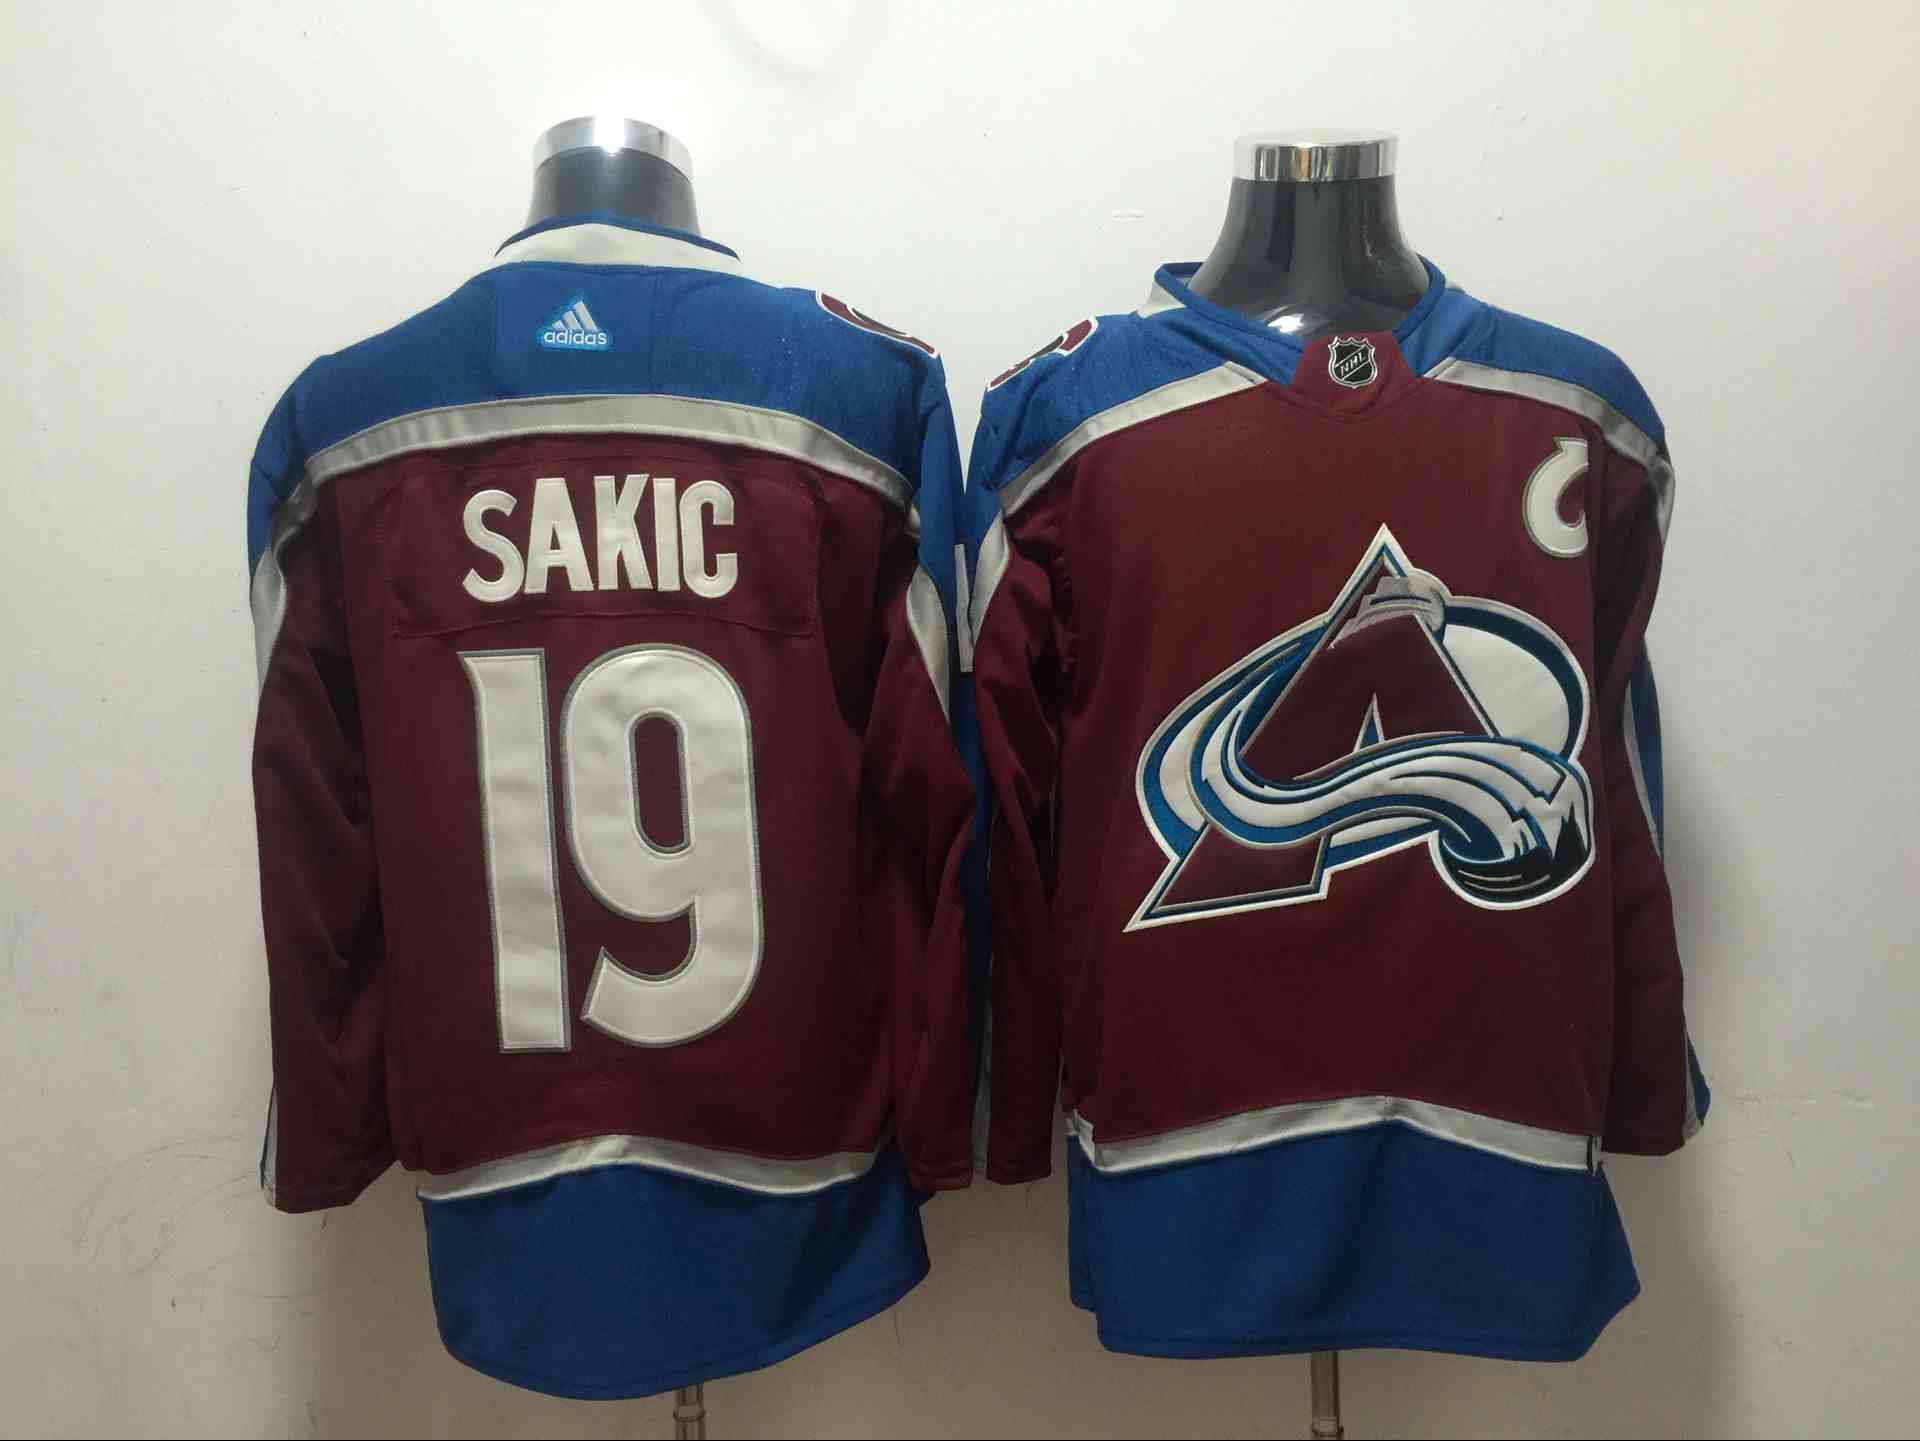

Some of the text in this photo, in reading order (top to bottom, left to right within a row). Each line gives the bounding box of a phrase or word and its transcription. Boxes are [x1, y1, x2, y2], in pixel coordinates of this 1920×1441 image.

[544, 329, 608, 345] adidas
[1340, 351, 1368, 377] NHL
[462, 474, 738, 602] SAKIC
[1522, 437, 1589, 558] C
[457, 643, 765, 1053] 19
